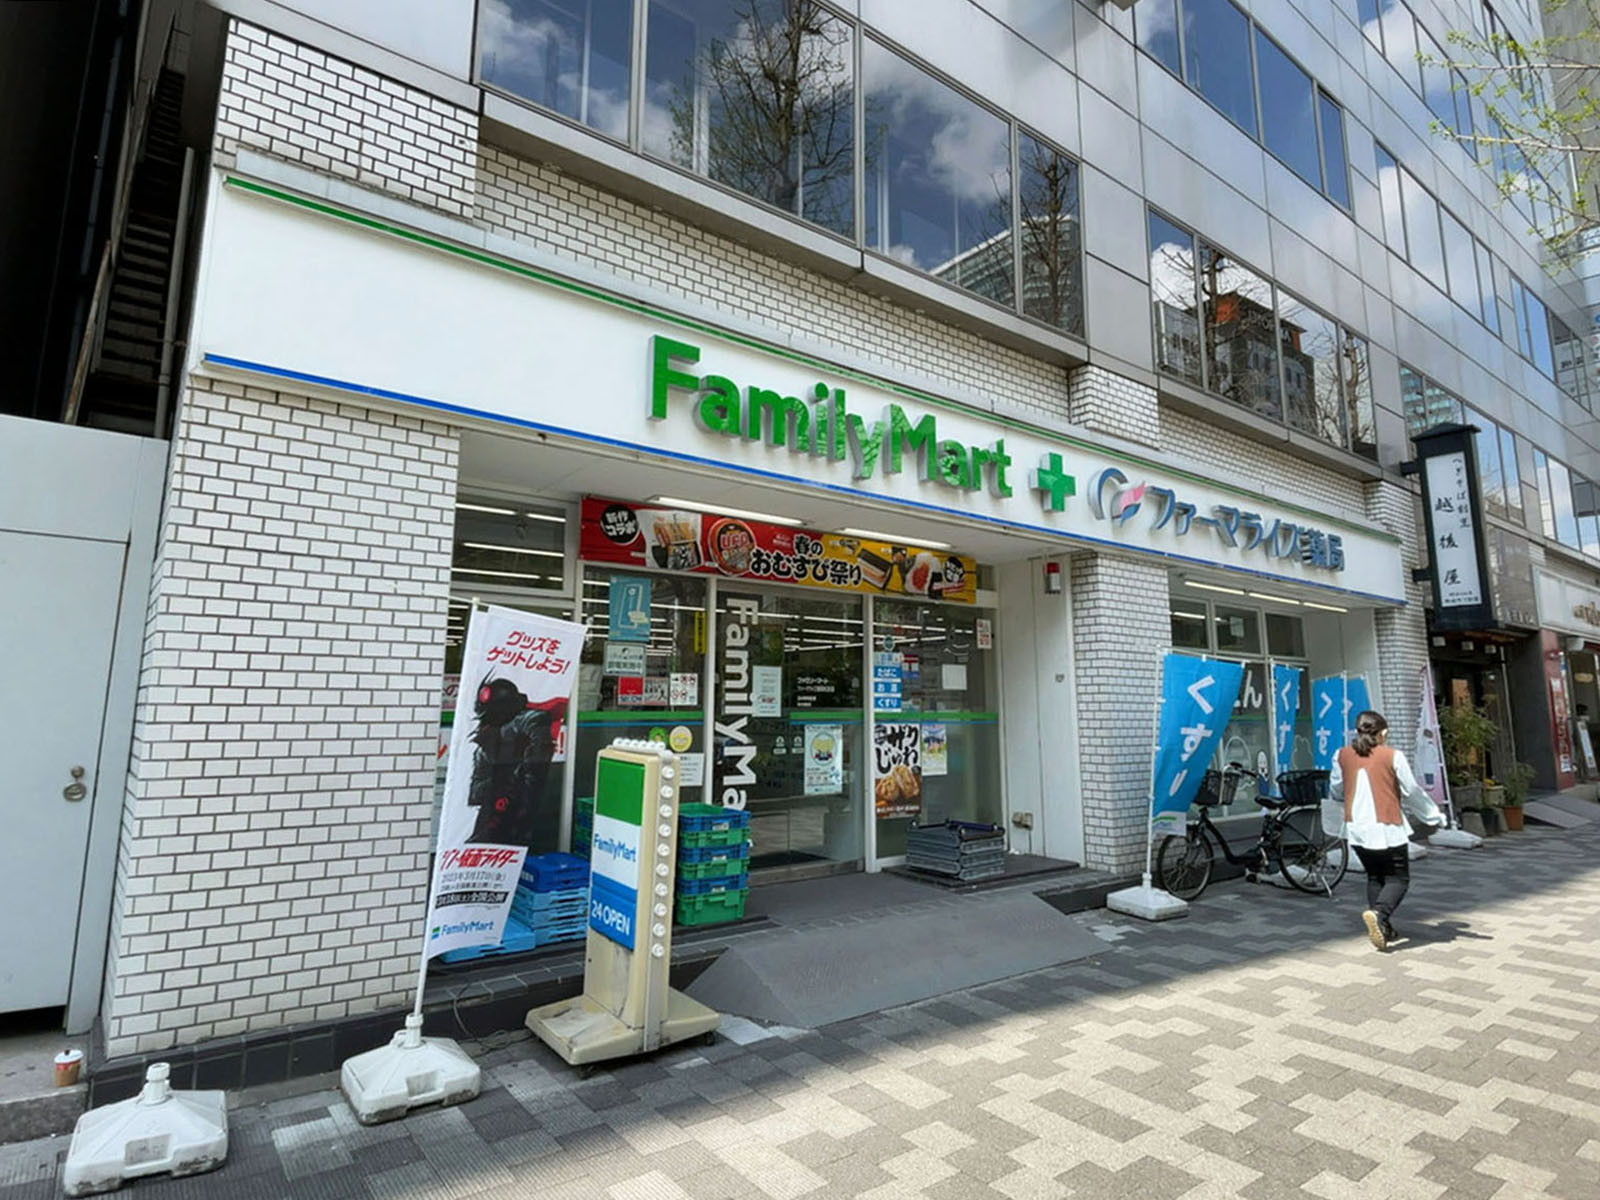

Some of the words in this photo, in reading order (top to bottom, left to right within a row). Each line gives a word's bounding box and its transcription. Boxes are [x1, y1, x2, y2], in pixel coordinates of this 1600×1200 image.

[647, 334, 1012, 499] FamilyMart
[750, 548, 864, 587] おむすび祭り
[505, 630, 561, 655] グッズを
[1170, 674, 1216, 797] くすり
[1279, 680, 1292, 774] くす
[594, 833, 637, 862] FamilyMart
[441, 920, 494, 936] FamilyMart
[591, 899, 604, 921] 24
[603, 905, 631, 935] OPEN
